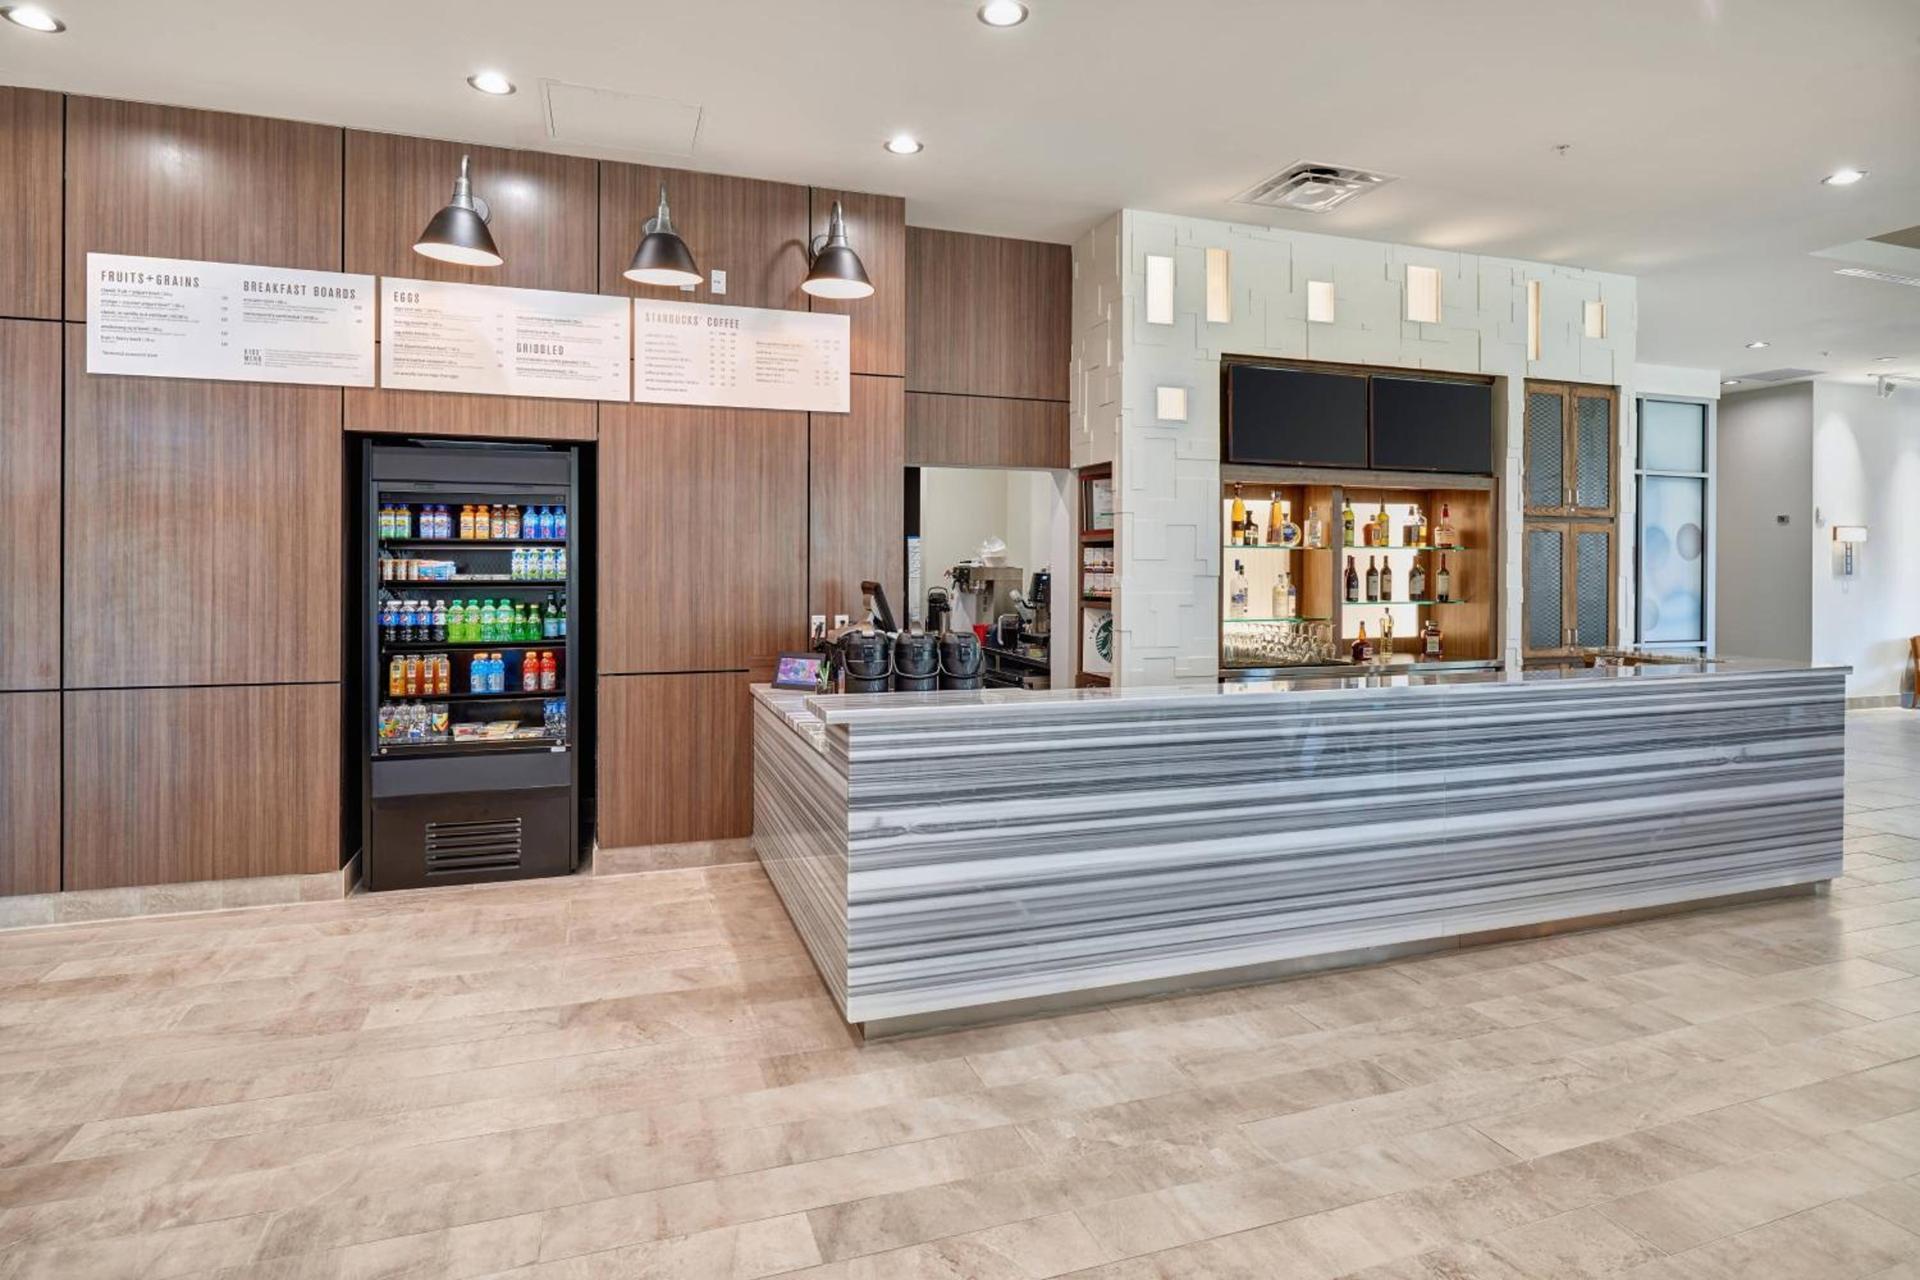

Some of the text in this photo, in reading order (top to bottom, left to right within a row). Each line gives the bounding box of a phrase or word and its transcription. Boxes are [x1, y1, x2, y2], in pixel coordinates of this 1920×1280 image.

[101, 270, 200, 288] FRUITS+GRAINS
[243, 280, 356, 300] BREAKFAST BOARDS
[393, 291, 420, 304] EGGS
[707, 316, 740, 329] COFFEE
